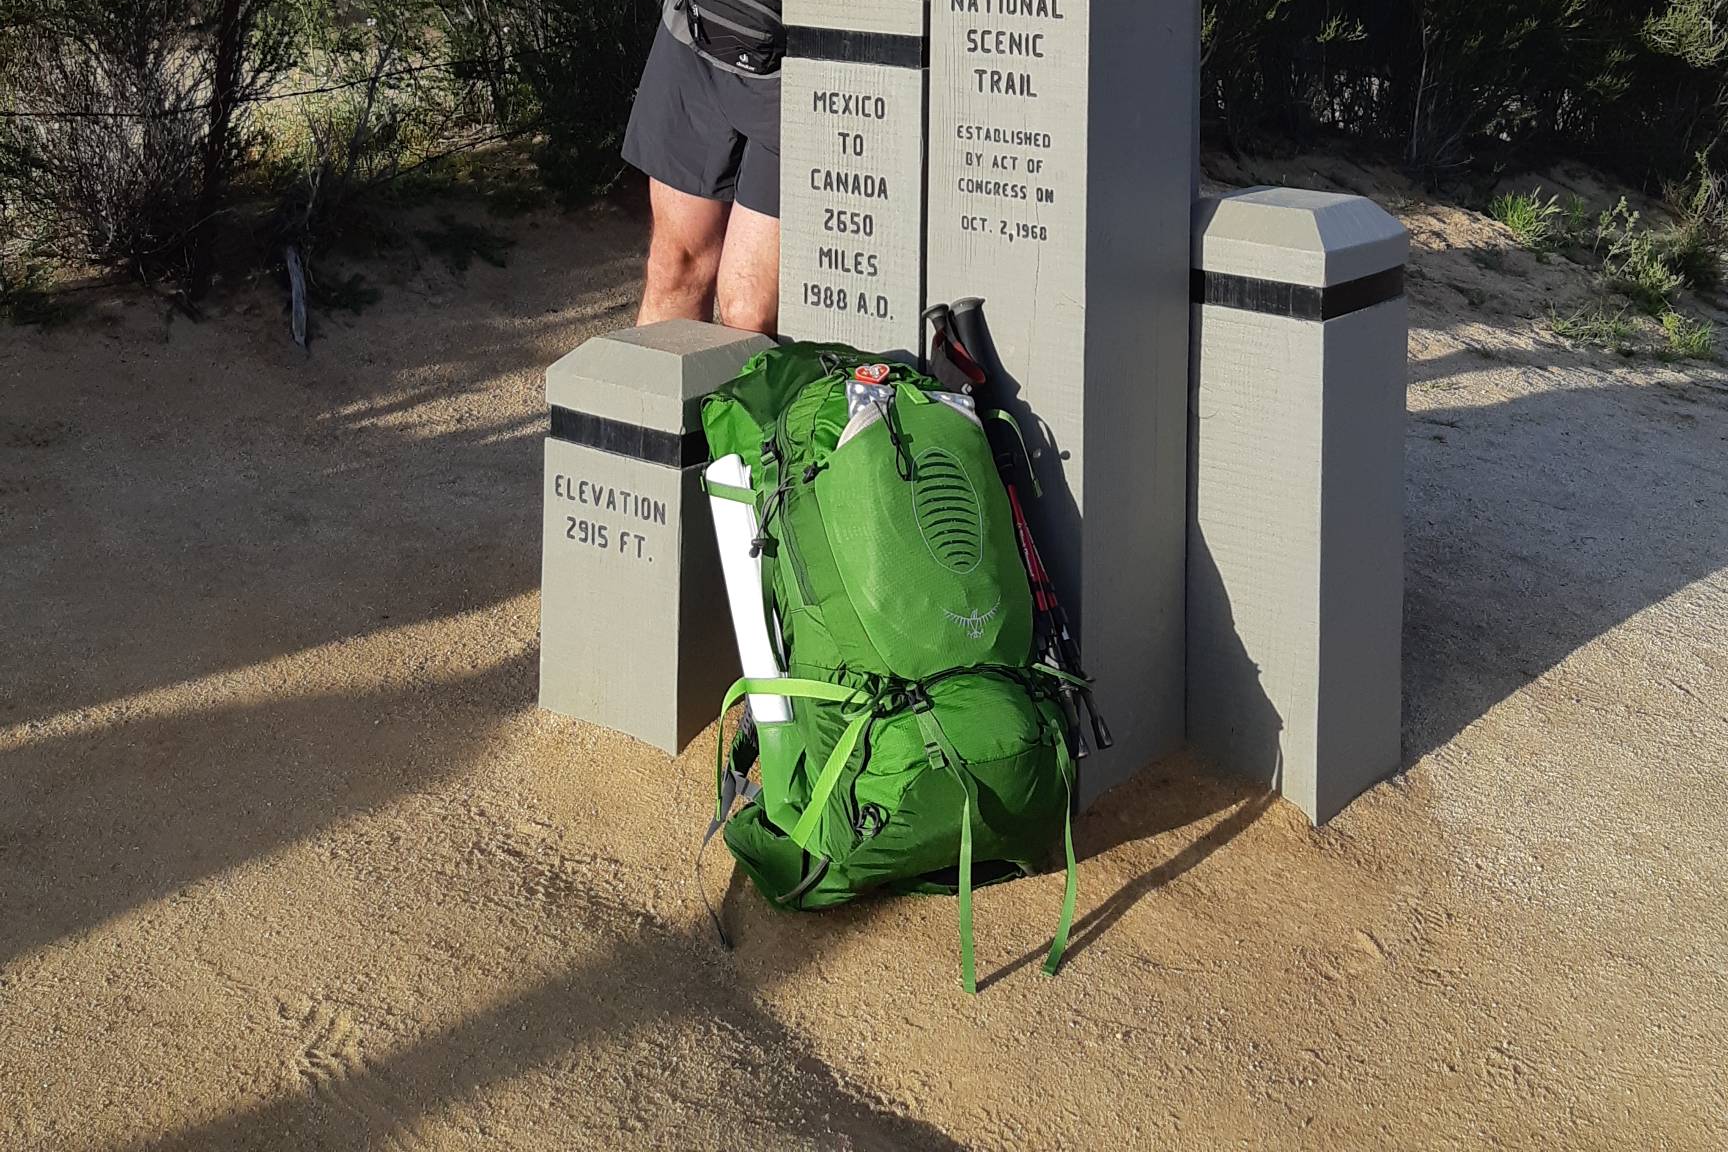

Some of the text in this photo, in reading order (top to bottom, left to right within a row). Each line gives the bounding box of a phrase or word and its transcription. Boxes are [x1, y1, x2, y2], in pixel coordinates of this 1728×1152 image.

[966, 28, 1044, 58] SCENIC
[973, 68, 1038, 98] TRAIL
[813, 90, 886, 120] MEXICO
[837, 131, 864, 157] TO
[956, 124, 1051, 149] ESTABLISHED
[965, 151, 1043, 174] BY ACT OF
[810, 168, 889, 201] CANADA
[957, 177, 1054, 204] CONGRESS ON
[823, 208, 874, 237] 2650
[961, 215, 992, 234] OCT.
[818, 246, 878, 277] MILES
[803, 282, 894, 321] 1988 A.D.
[555, 474, 666, 526] ELEVATION
[566, 516, 653, 562] 2915 FT.
